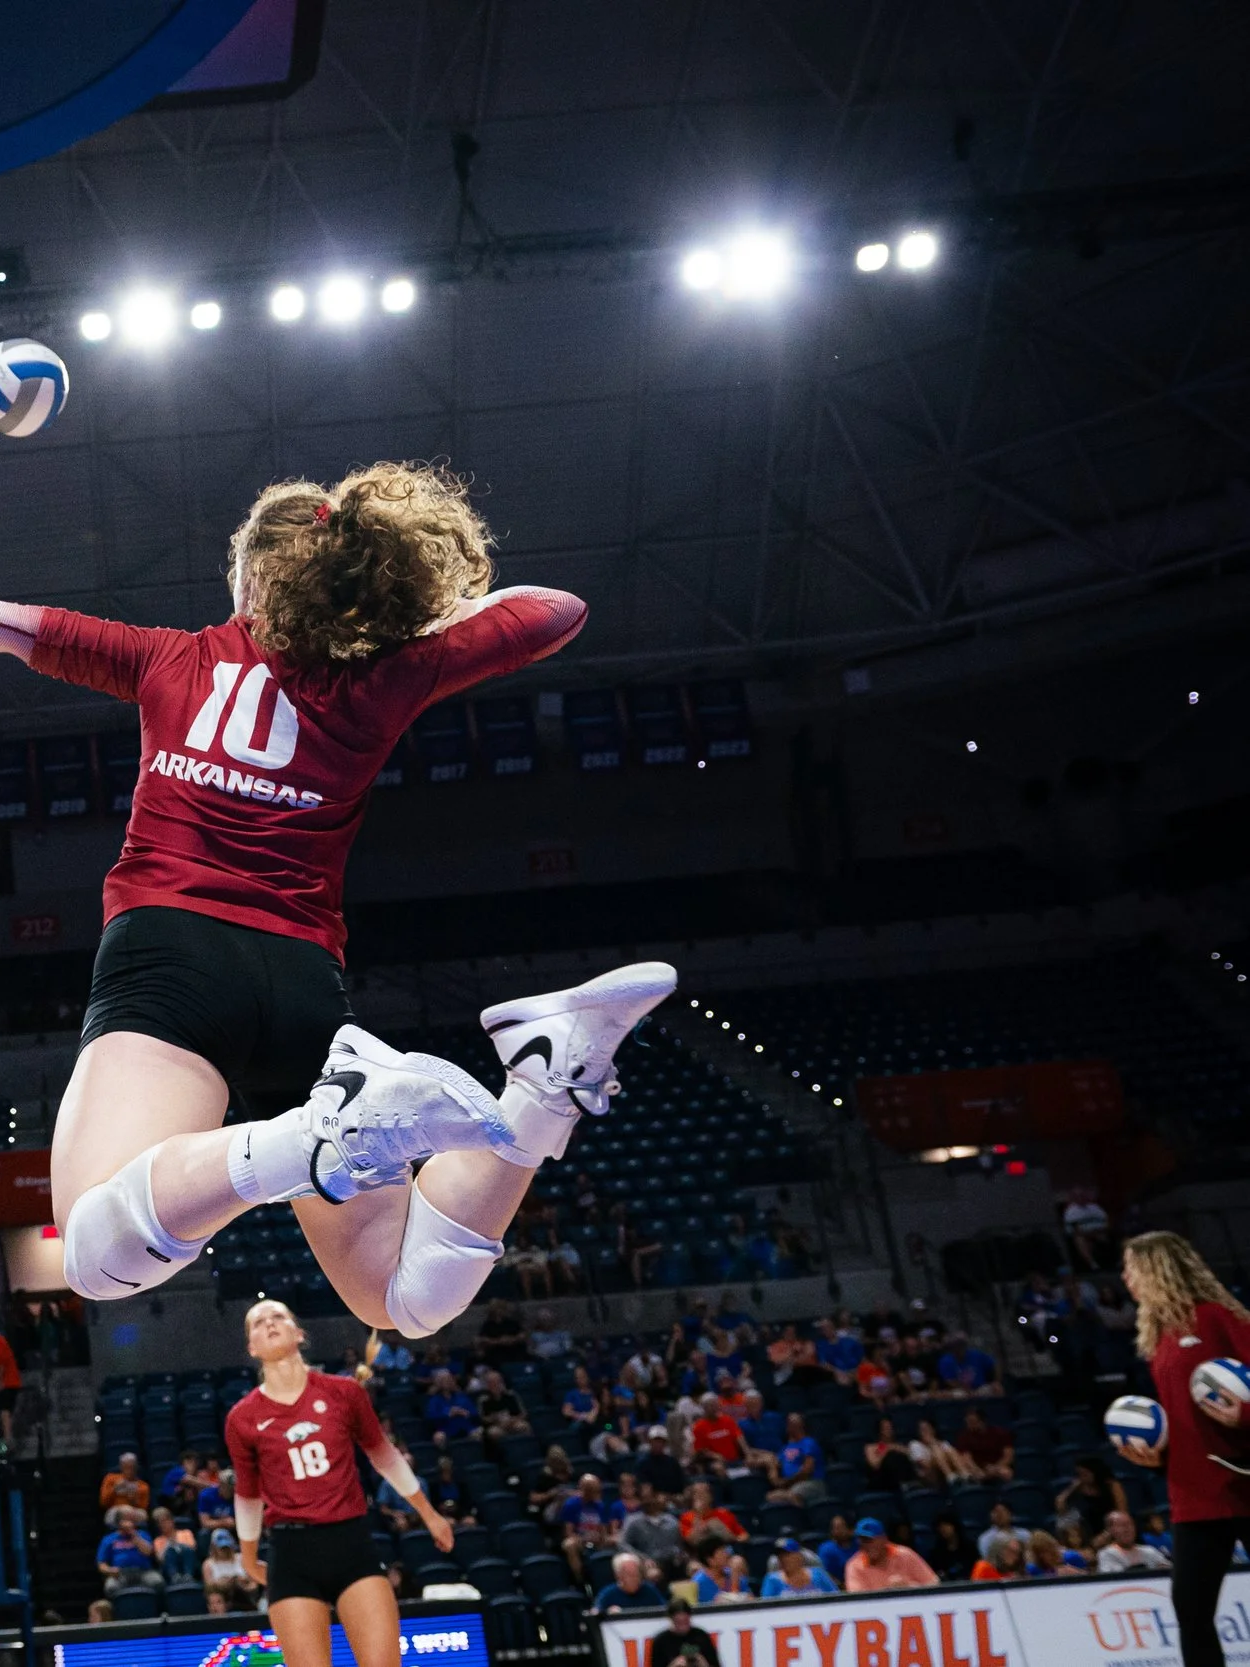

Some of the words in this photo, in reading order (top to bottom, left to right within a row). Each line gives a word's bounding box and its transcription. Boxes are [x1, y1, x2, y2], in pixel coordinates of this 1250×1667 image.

[184, 660, 299, 770] 10
[148, 749, 324, 810] ARKANSAS
[20, 917, 56, 940] 212
[288, 1441, 331, 1481] 18
